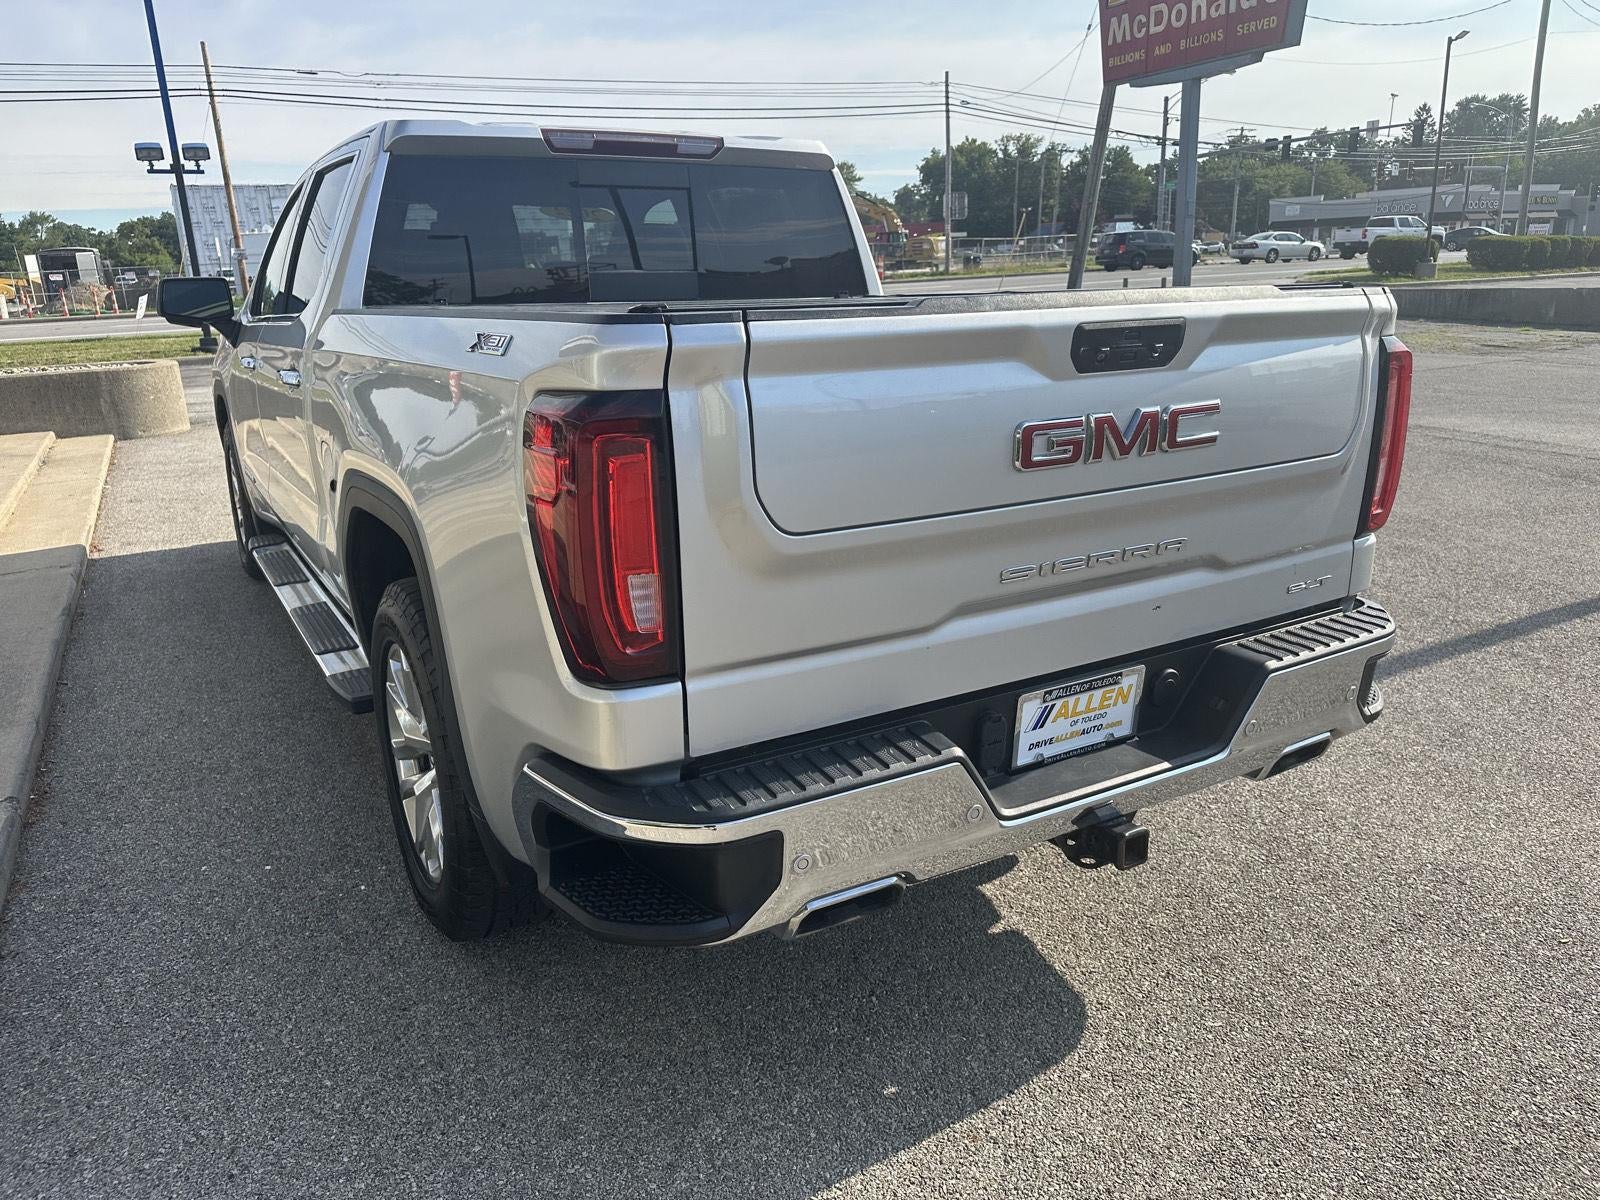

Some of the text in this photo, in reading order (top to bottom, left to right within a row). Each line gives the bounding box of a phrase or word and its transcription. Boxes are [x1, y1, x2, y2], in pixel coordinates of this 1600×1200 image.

[1107, 0, 1275, 46] McDona
[1108, 16, 1278, 67] BILLIONS AND BILLIONS SERVED
[1013, 398, 1222, 472] GMC
[1000, 537, 1188, 584] SIERRA
[1286, 575, 1333, 595] SLT
[1051, 684, 1133, 724] ALLEN
[1057, 676, 1116, 698] ALLEN OF TOLEDO
[1028, 720, 1123, 751] DRIVEALLENAUTO.com
[1070, 711, 1108, 727] OF TOLEDO
